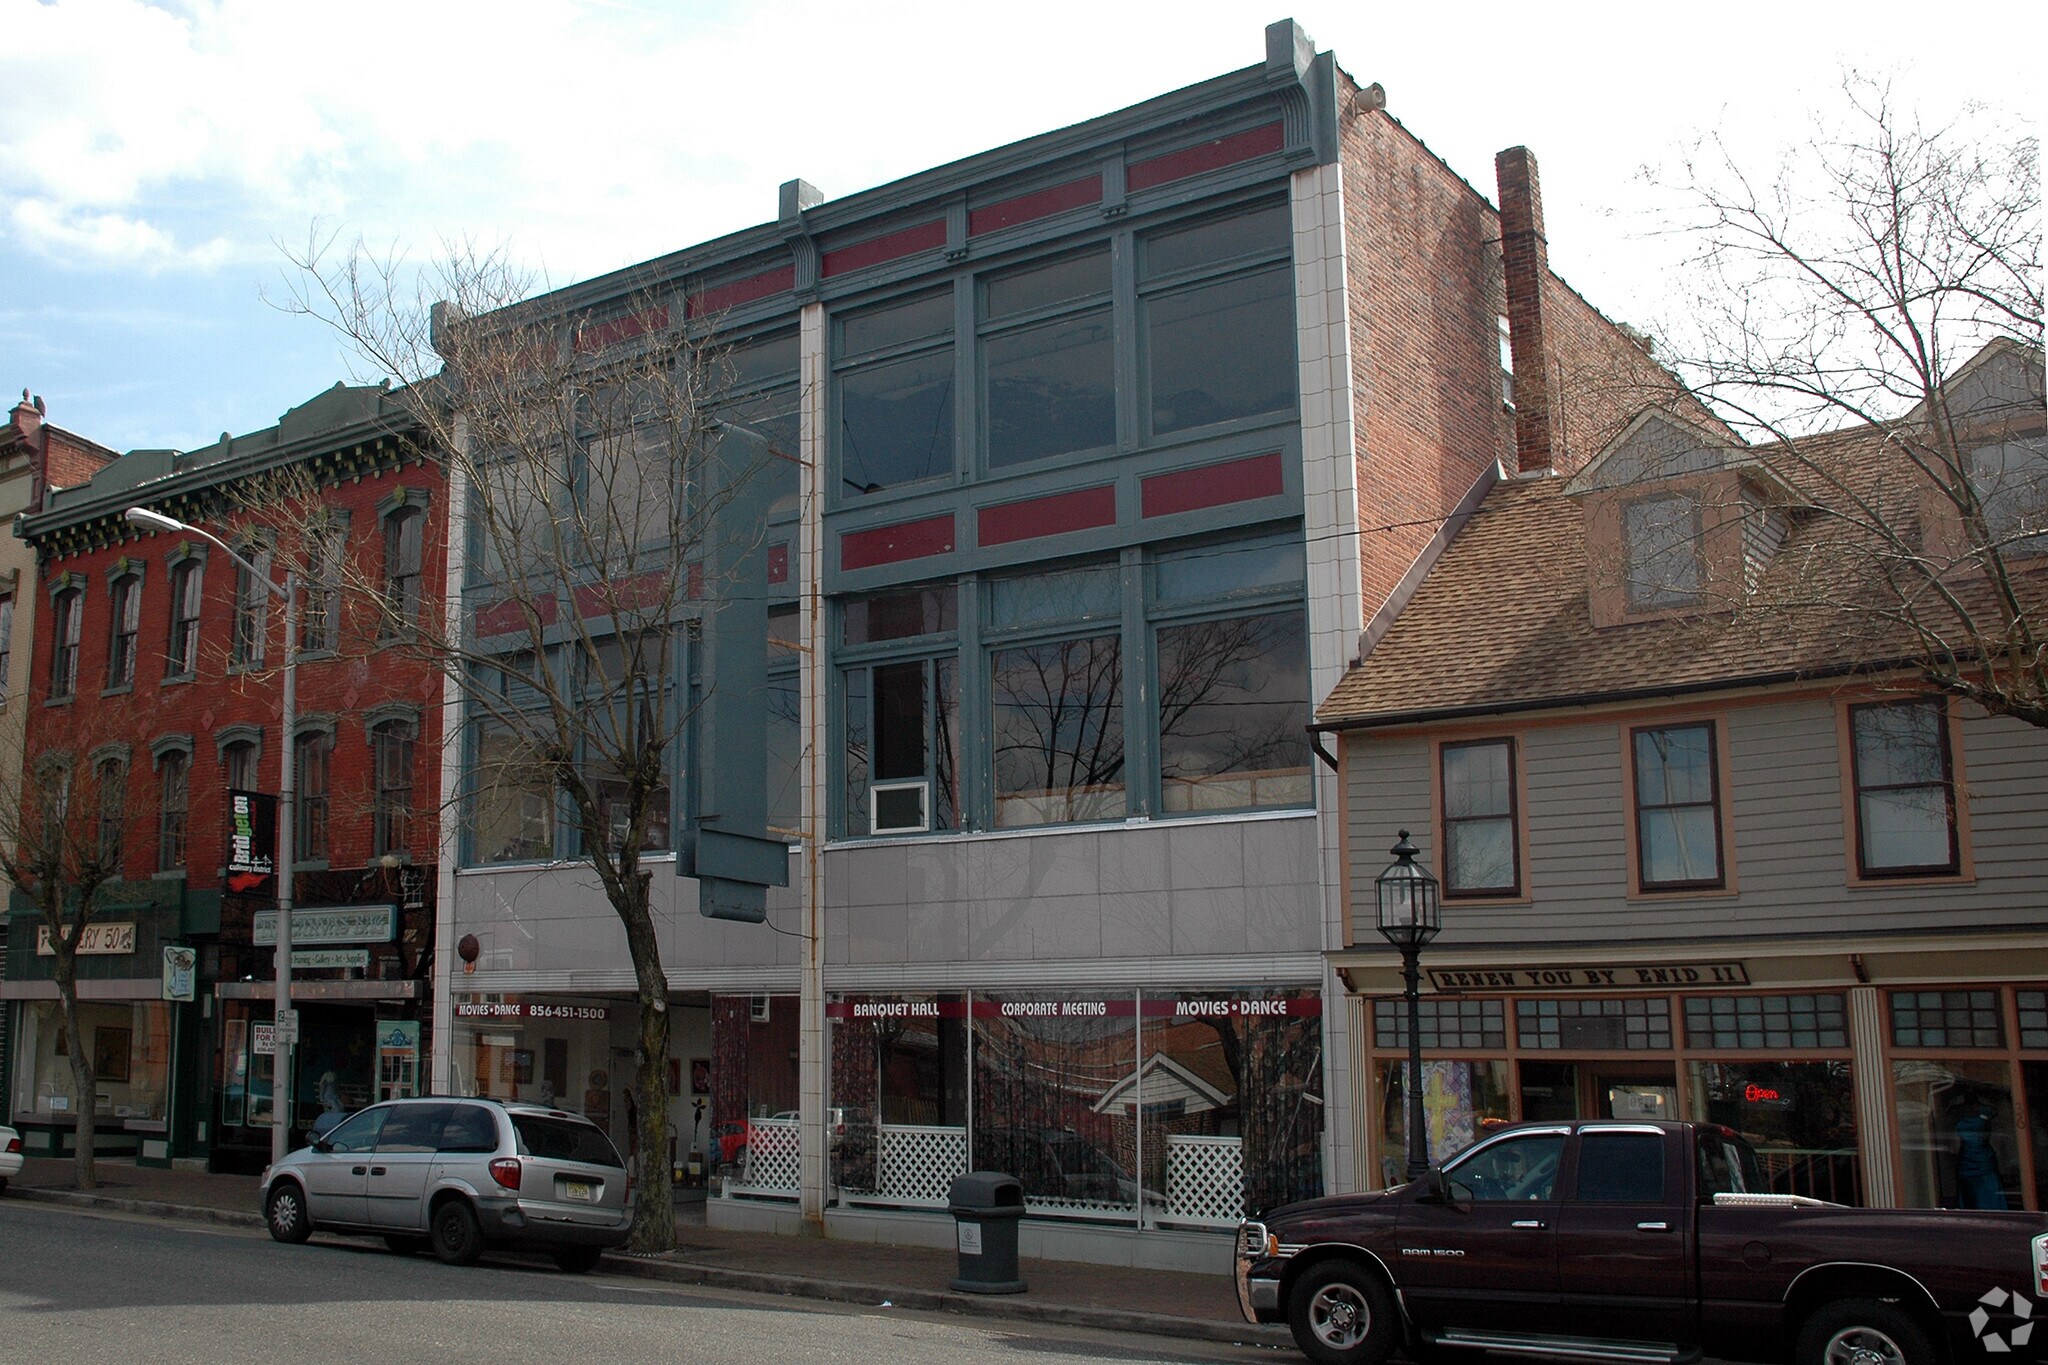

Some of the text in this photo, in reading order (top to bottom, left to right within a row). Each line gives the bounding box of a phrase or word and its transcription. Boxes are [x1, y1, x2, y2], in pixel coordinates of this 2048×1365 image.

[232, 795, 253, 864] Bridgeton
[1439, 966, 1737, 987] RENEW YOU BY ENID II
[529, 1004, 605, 1019] 856-451-1500
[853, 1001, 939, 1018] BANQUET HALL
[1001, 1001, 1107, 1016] CORPORATE MEETING
[1176, 1000, 1287, 1015] MOVIES DANCE
[1402, 1248, 1431, 1256] RAM
